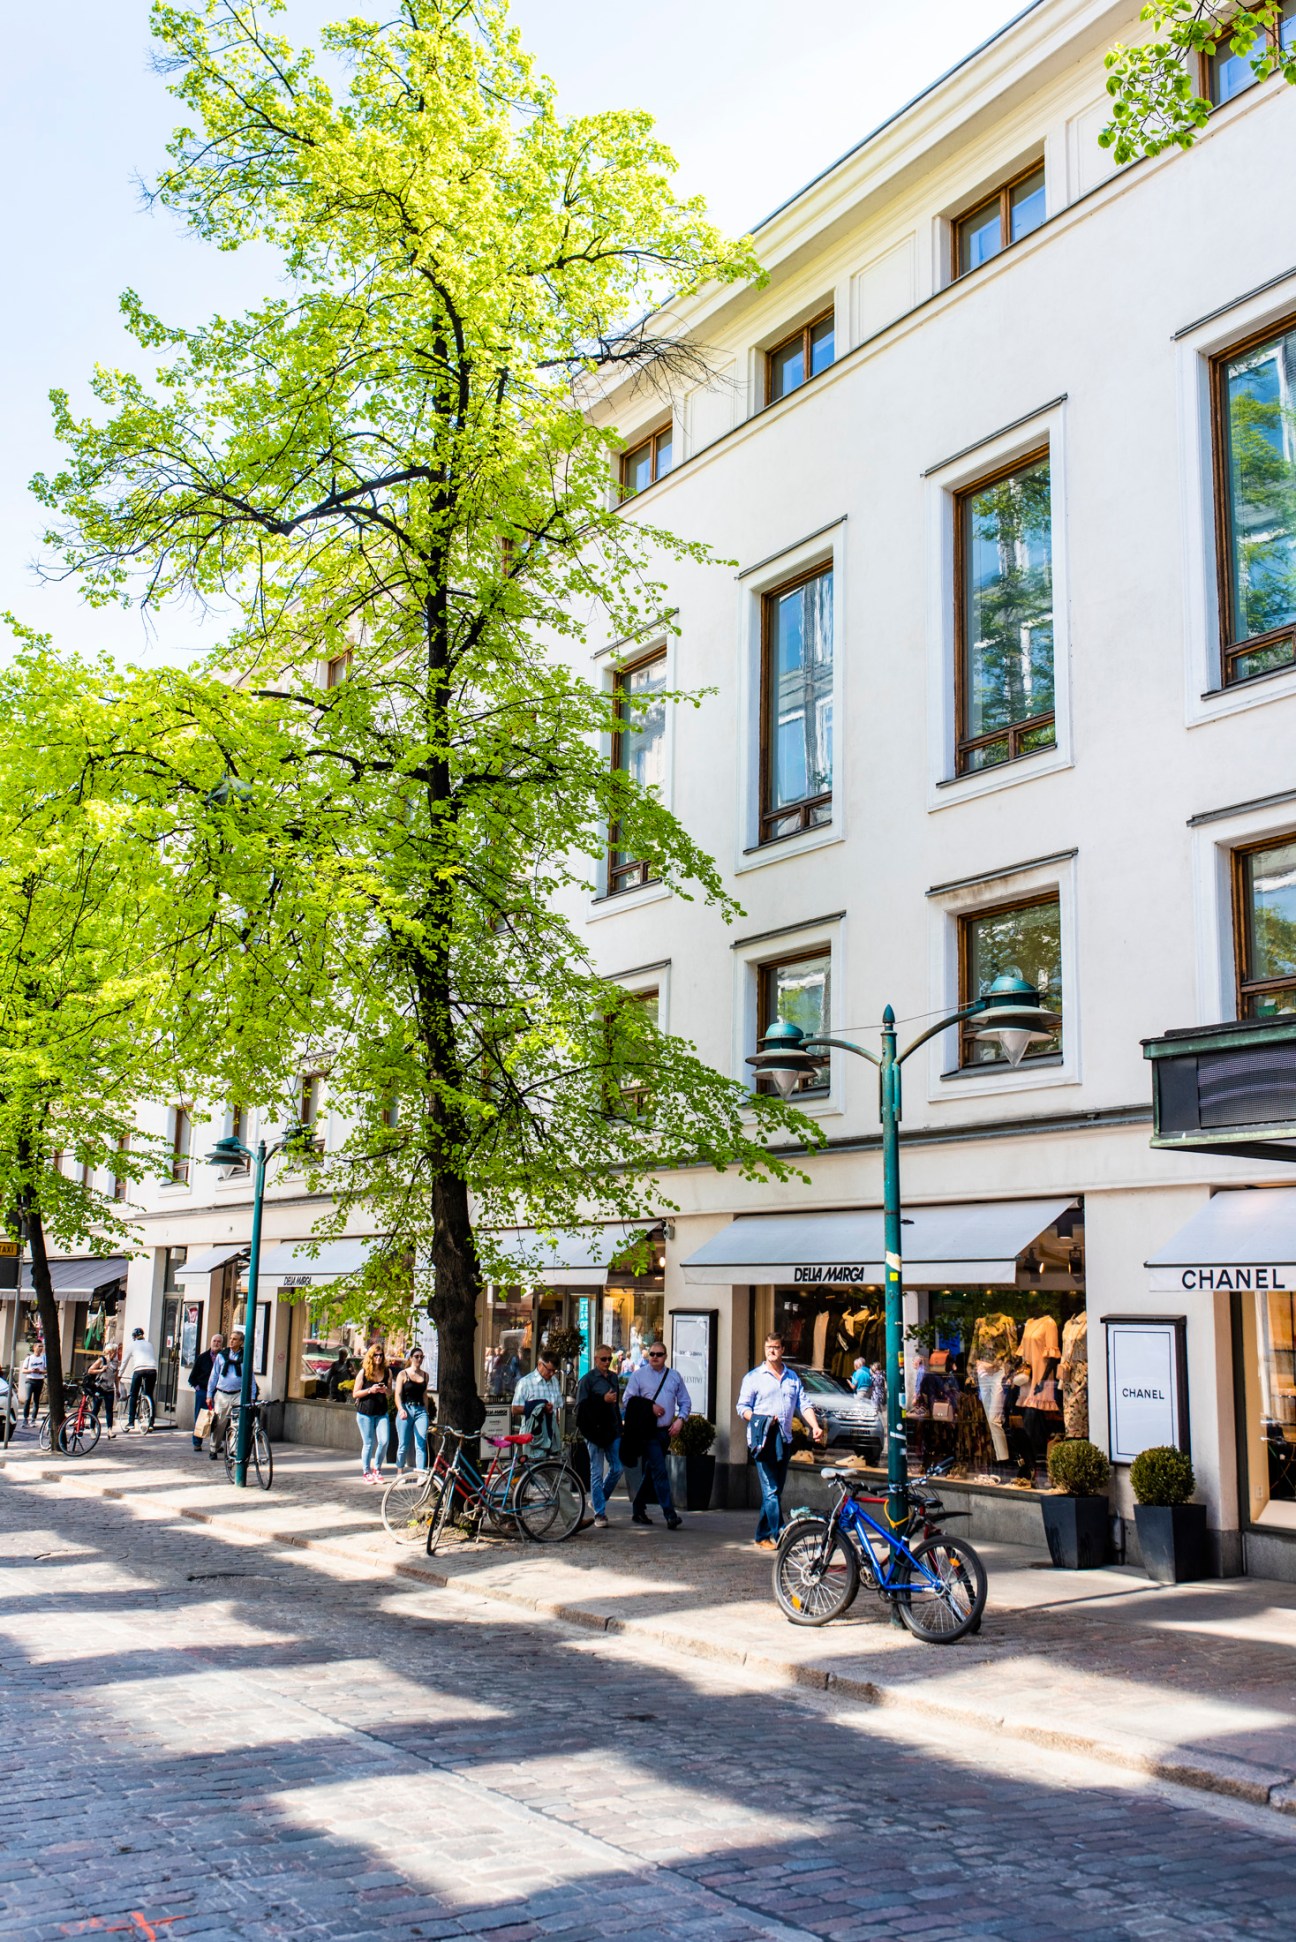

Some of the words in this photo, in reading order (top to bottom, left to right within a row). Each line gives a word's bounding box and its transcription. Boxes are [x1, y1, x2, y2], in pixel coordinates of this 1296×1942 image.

[794, 1267, 822, 1282] DELLA
[822, 1266, 864, 1282] MARGA
[1182, 1269, 1285, 1290] CHANEL
[1122, 1388, 1165, 1400] CHANEL
